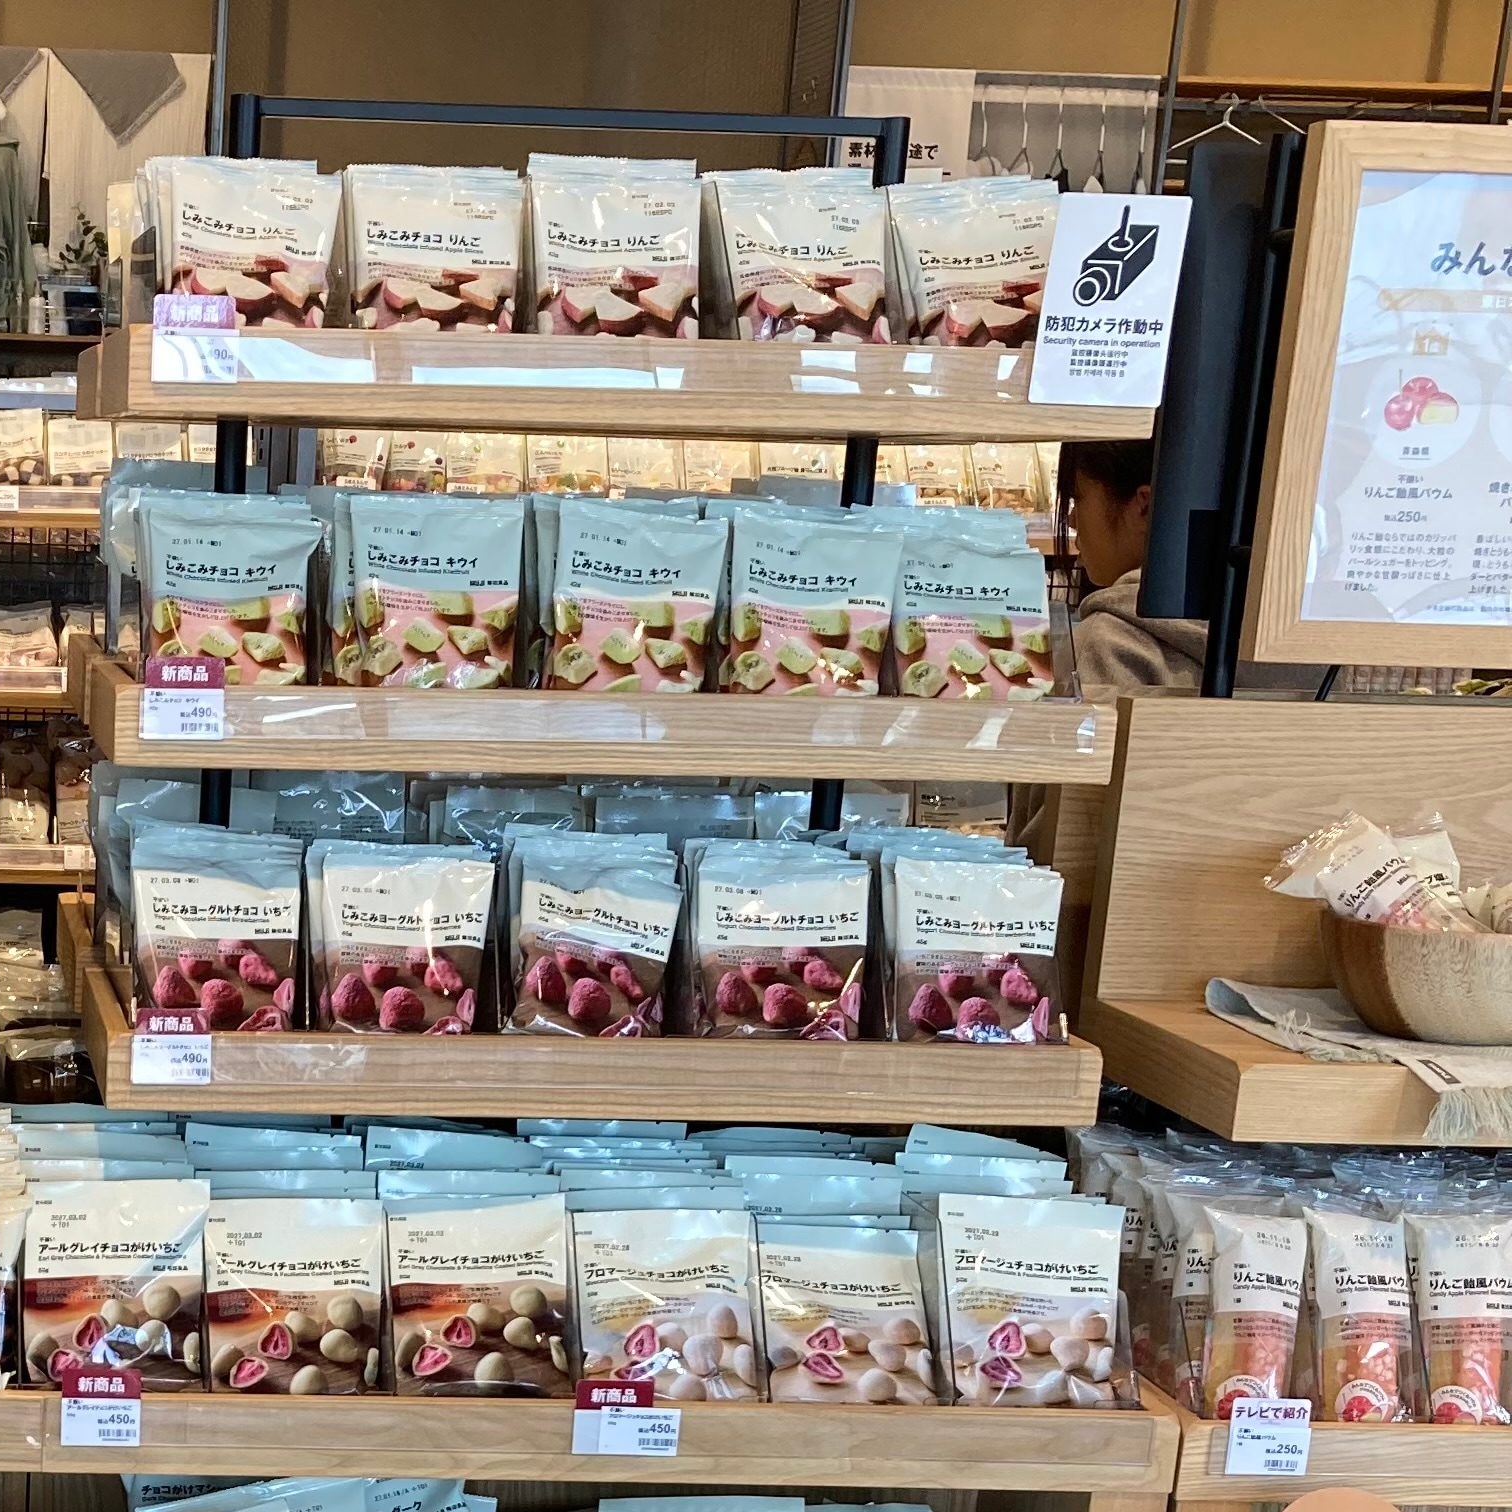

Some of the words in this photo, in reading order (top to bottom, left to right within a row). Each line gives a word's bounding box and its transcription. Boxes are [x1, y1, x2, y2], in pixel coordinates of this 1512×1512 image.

[263, 227, 296, 236] りんご
[367, 229, 442, 244] しみこみチョコ
[450, 235, 481, 247] りんご
[548, 229, 620, 247] しみこみチョコ
[627, 234, 660, 246] りんご
[817, 244, 848, 255] りんご
[920, 254, 994, 266] しみこみチョコ
[1001, 245, 1035, 259] りんご
[170, 304, 220, 322] 新商品
[1045, 315, 1163, 335] 防犯カメラ作動中
[1043, 336, 1076, 346] Security
[1079, 338, 1108, 346] camera
[1111, 338, 1118, 346] in
[1120, 339, 1160, 348] operation
[367, 551, 440, 567] しみこみチョコ
[446, 557, 478, 568] キウイ
[572, 557, 643, 578] しみこみチョコ
[649, 568, 681, 578] キウイ
[166, 559, 239, 577] しみこみチョコ
[245, 565, 277, 577] キウイ
[749, 564, 819, 585] しみこみチョコ
[825, 575, 858, 587] キウイ
[904, 581, 974, 595] しみこみチョコ
[980, 587, 1010, 597] キウイ
[162, 665, 209, 682] 新商品
[153, 904, 259, 916] しみこみヨーグルトチョコ
[455, 912, 483, 924] いちご
[539, 898, 638, 929] しみこみヨーグルトチョコ
[643, 923, 669, 938] いちご
[829, 912, 858, 923] いちご
[916, 916, 1024, 931] しみこみヨーグルトチョコ
[1029, 921, 1055, 932] いちご
[150, 1016, 194, 1032] 新商品
[38, 1242, 182, 1254] アールグレイチョコがけいちご
[398, 1250, 545, 1265] アールグレイチョコがけいちご
[584, 1263, 730, 1279] フロマージュチョコがけいちご
[761, 1273, 901, 1294] フロマージュチョコがけいちご
[78, 1376, 126, 1393] 新商品
[591, 1388, 638, 1404] 新商品
[1235, 1406, 1308, 1419] テレビで紹介
